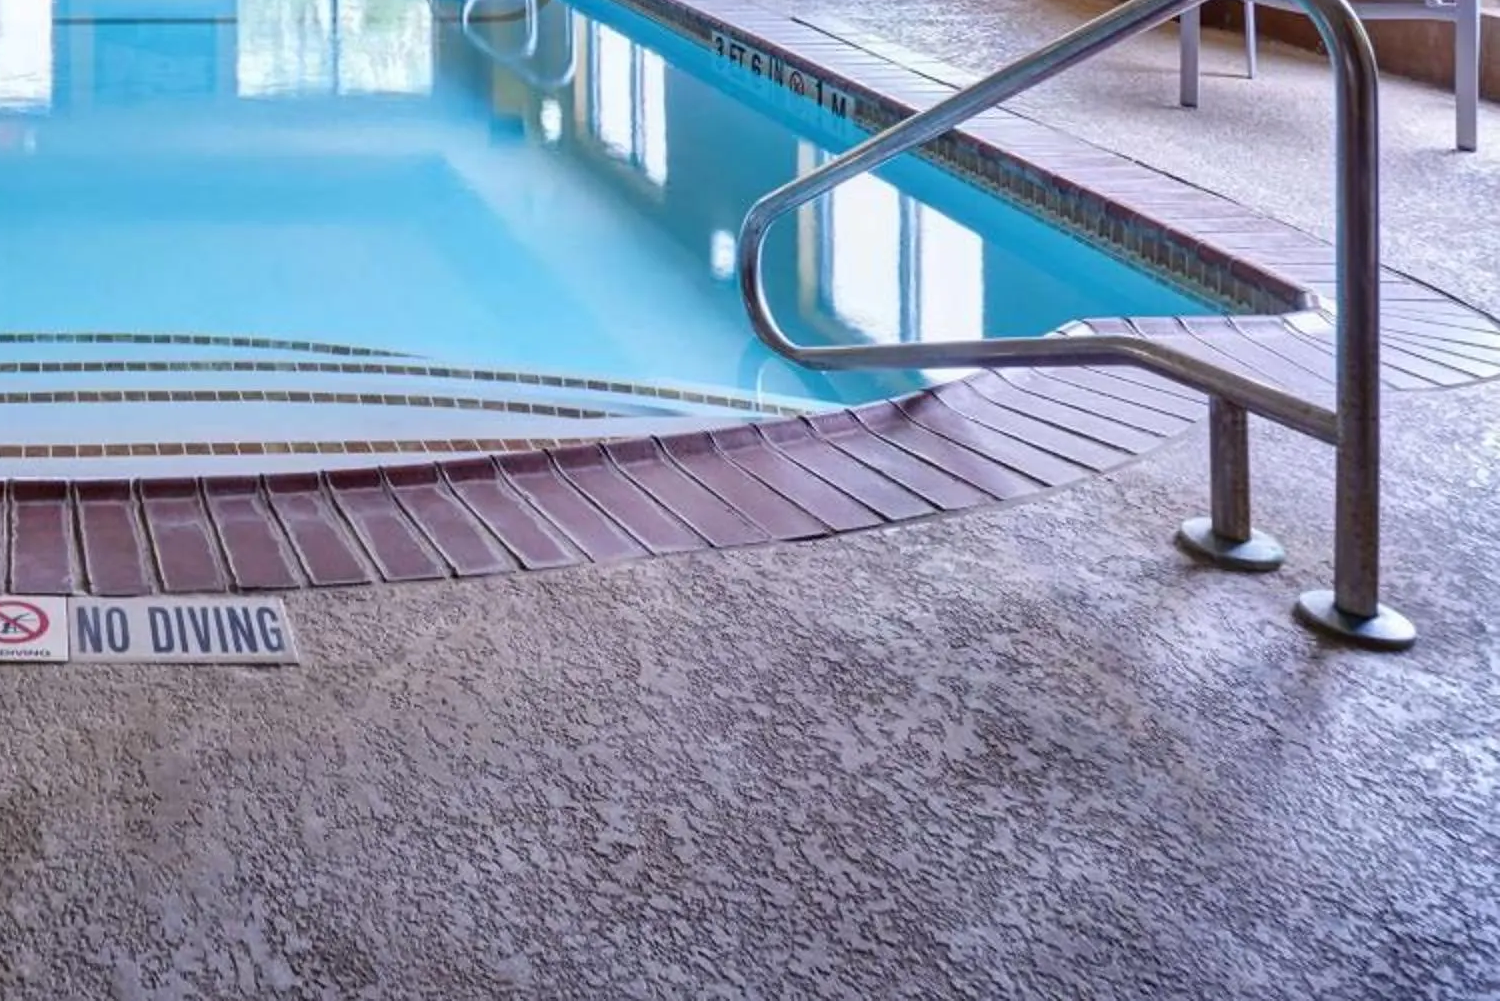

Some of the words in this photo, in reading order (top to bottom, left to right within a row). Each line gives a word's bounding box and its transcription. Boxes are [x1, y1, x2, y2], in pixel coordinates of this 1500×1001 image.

[715, 37, 724, 57] 3
[730, 42, 745, 68] FT
[752, 54, 761, 75] 6
[769, 55, 783, 86] IN
[832, 92, 846, 119] M
[0, 648, 51, 657] DIVING
[76, 606, 130, 654] NO
[148, 606, 286, 654] DIVING
